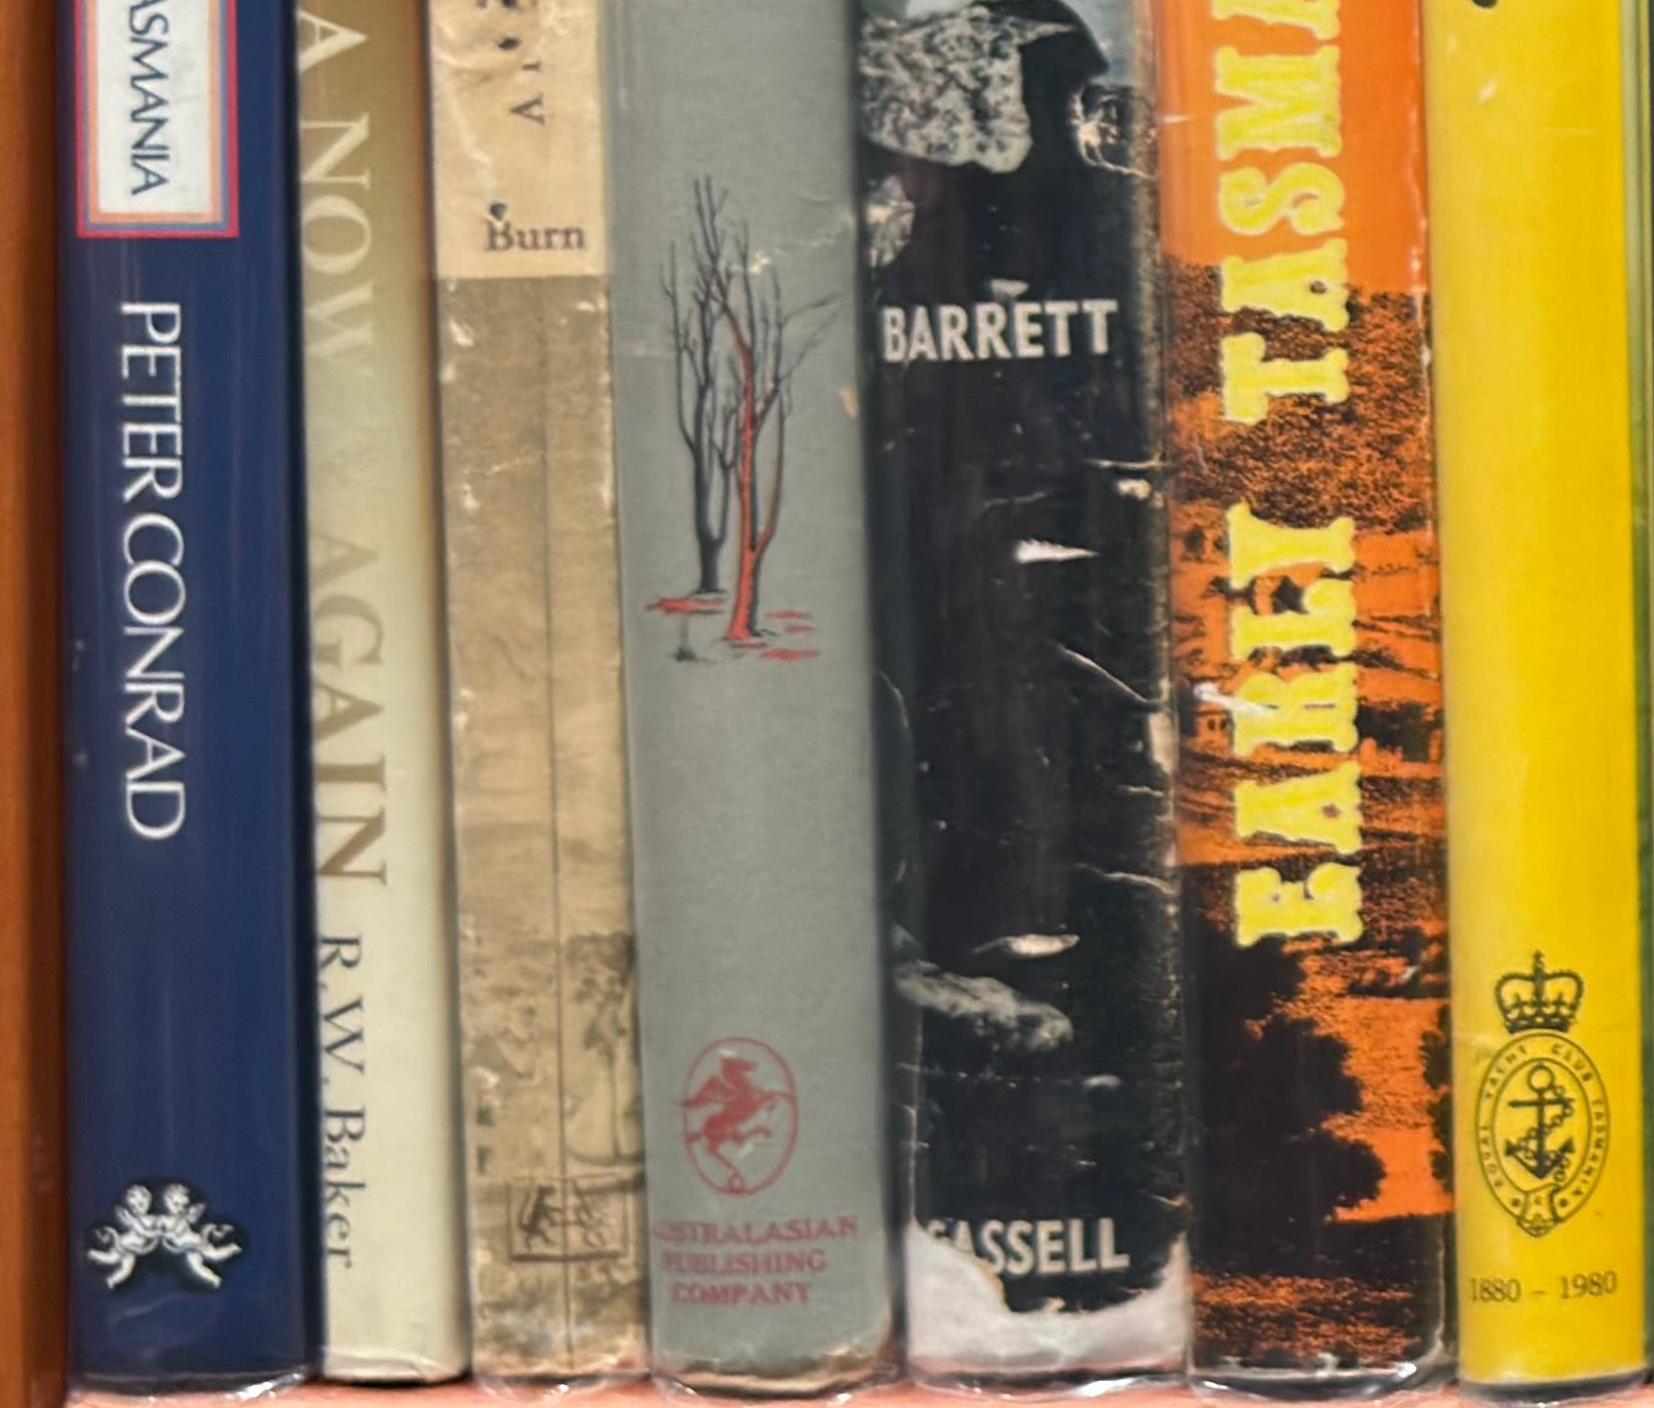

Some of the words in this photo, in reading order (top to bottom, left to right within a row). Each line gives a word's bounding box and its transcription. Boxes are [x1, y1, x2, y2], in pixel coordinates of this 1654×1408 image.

[509, 94, 546, 127] A
[298, 112, 375, 377] NOW
[485, 219, 586, 253] Burn
[882, 298, 1119, 363] BARRETT
[120, 299, 183, 504] PETER
[121, 513, 187, 841] CONRAD
[310, 532, 389, 887] AGAIN
[1226, 502, 1365, 950] EARLY
[319, 1108, 366, 1270] Baker
[653, 1214, 858, 1246] STRALASIAN
[668, 1280, 811, 1307] COMPANY
[1469, 1276, 1522, 1304] 1880
[1559, 1270, 1618, 1300] 1980
